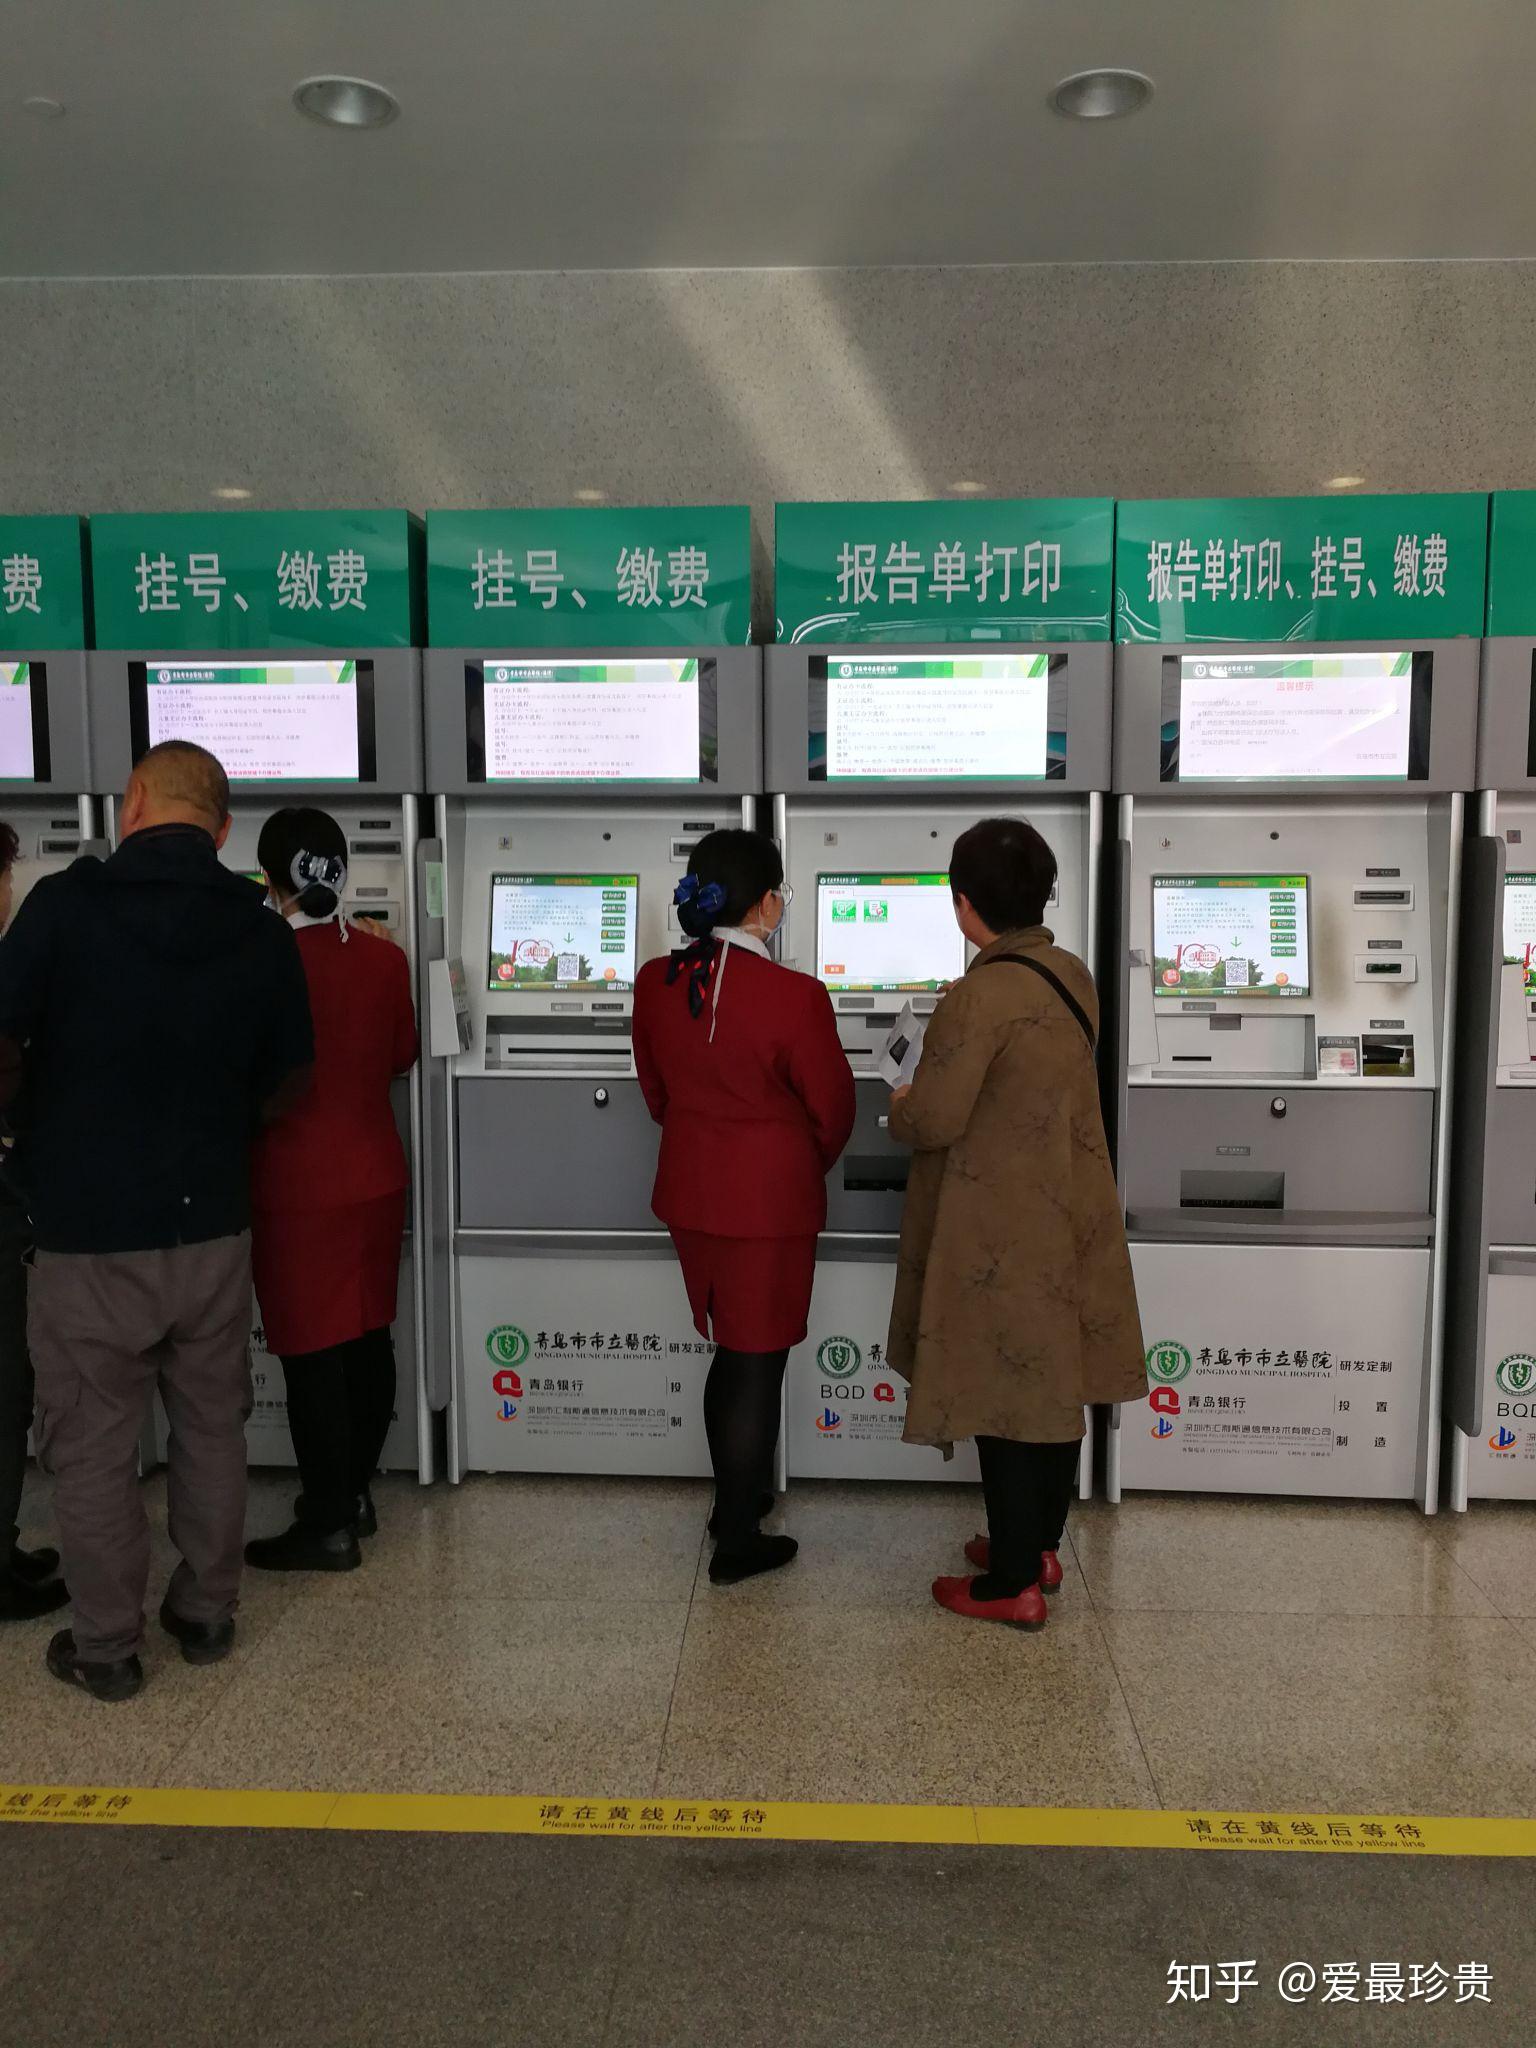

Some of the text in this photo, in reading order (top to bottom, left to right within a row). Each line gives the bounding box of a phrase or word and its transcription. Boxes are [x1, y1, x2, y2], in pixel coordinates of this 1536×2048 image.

[836, 540, 1062, 605] 报告单打印
[2, 552, 42, 614] 费
[534, 1352, 663, 1361] QINGDAO MUNICIPAL HOSPITAL
[1339, 1360, 1393, 1373] 研发定制
[1195, 1369, 1331, 1379] QINGDAO MUNICIPAL HOSPITAL
[529, 1378, 584, 1392] 青岛银行
[820, 1384, 865, 1399] BQD
[1187, 1395, 1247, 1409] 青岛银行
[0, 1792, 133, 1810] 线后等待
[539, 1804, 768, 1824] 请在黄线后等待
[542, 1820, 762, 1833] Please wait for after the yellow line
[1186, 1818, 1424, 1839] 请在黄线后等待
[1198, 1834, 1426, 1848] Please wait for after the yellow line
